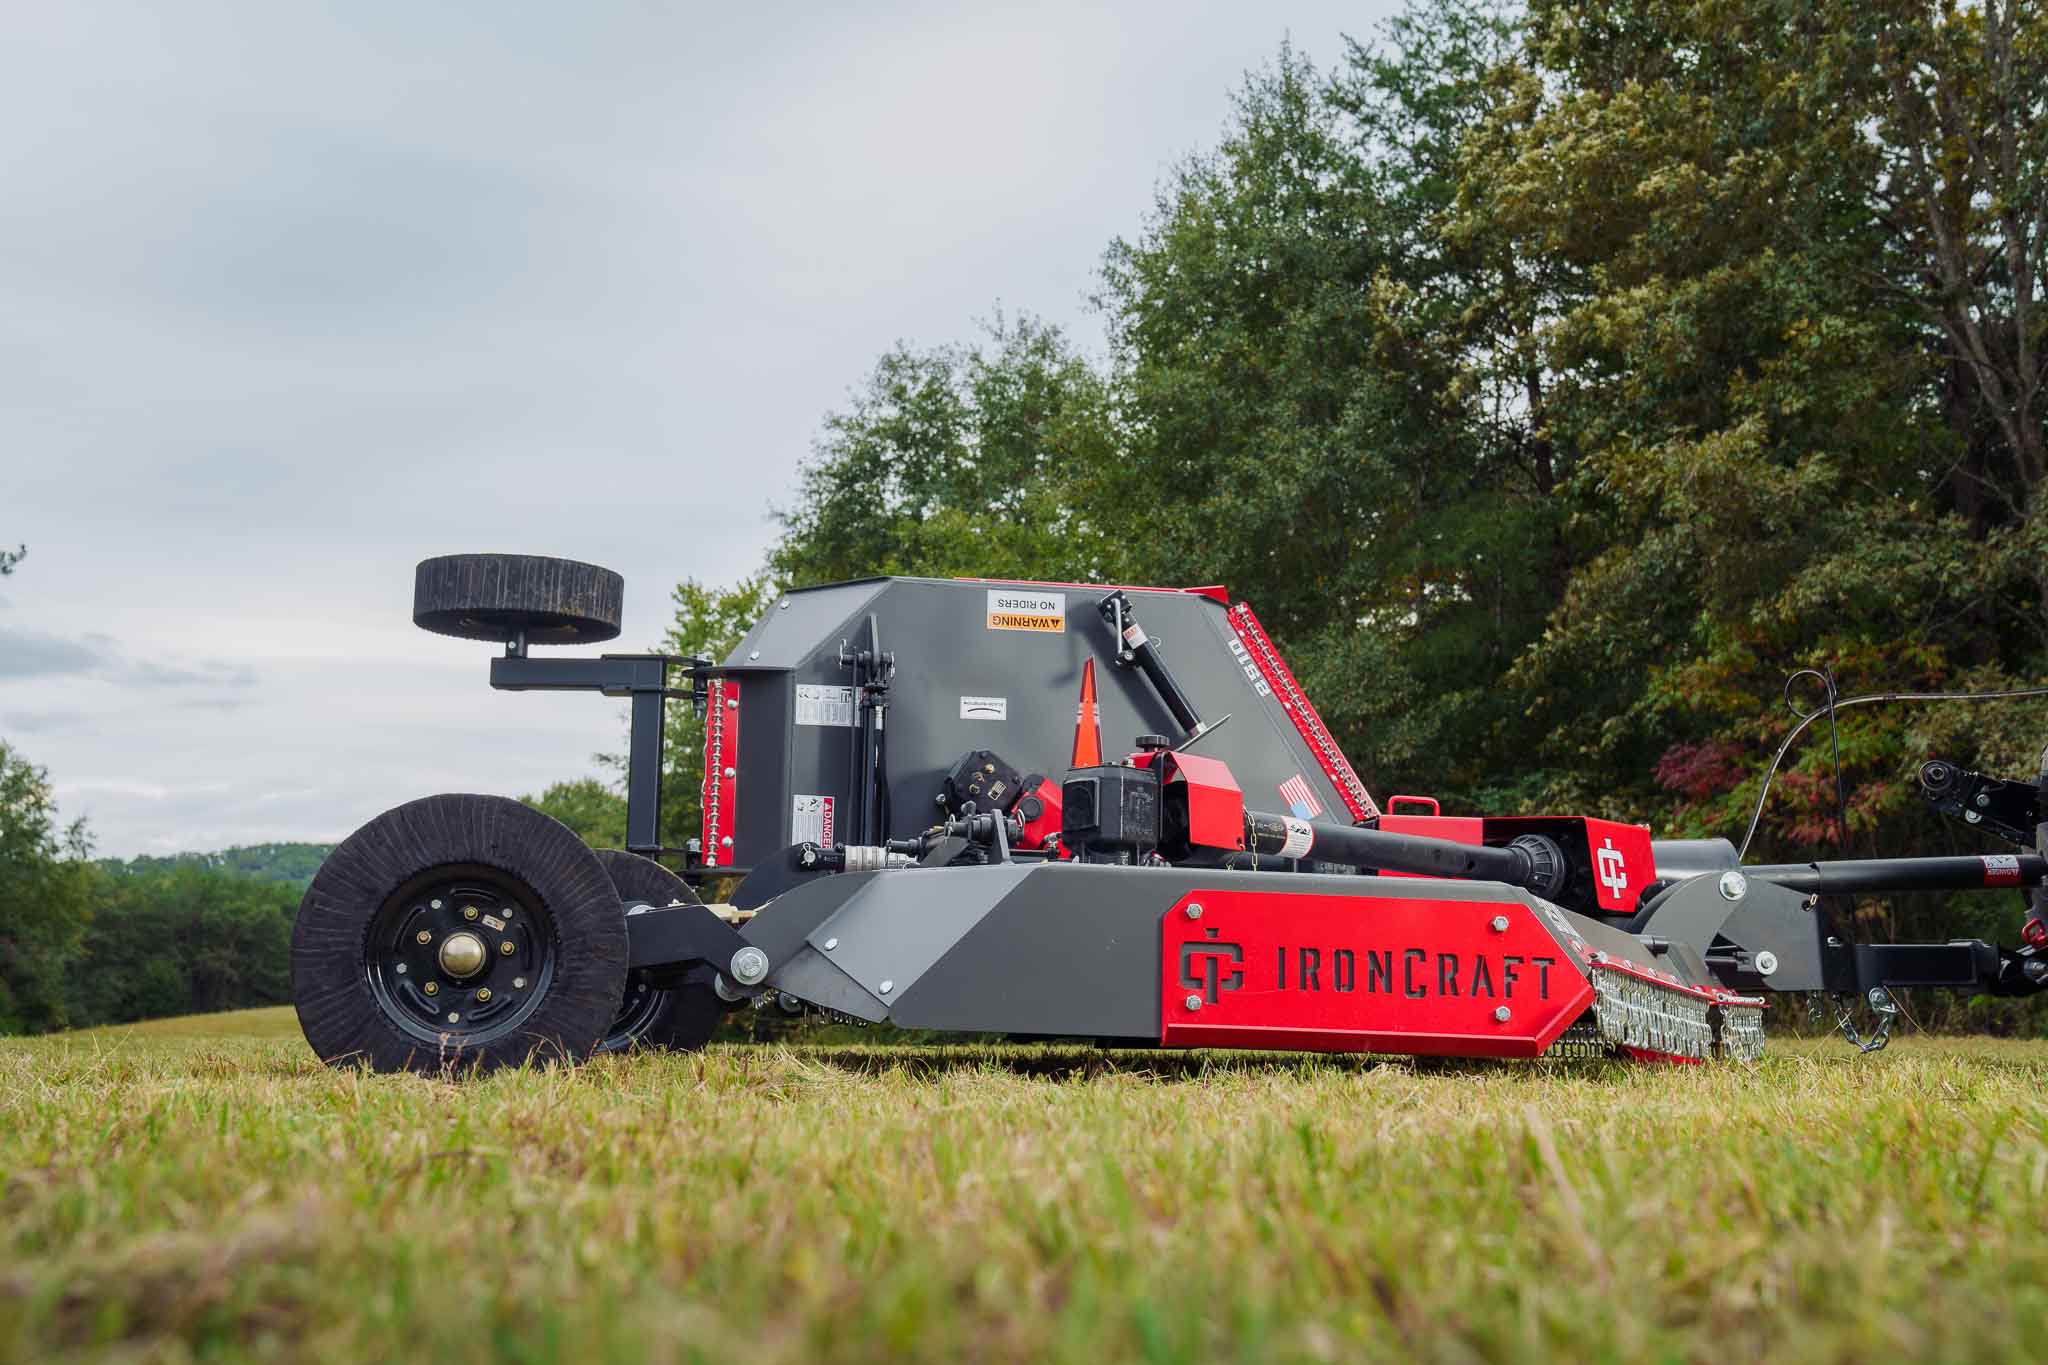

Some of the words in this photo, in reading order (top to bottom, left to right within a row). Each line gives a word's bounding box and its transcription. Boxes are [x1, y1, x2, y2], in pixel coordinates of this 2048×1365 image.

[998, 598, 1037, 609] RIDERS
[1040, 601, 1056, 610] NO
[993, 615, 1049, 628] WARNING
[1277, 946, 1556, 1001] IRONCRAFT
